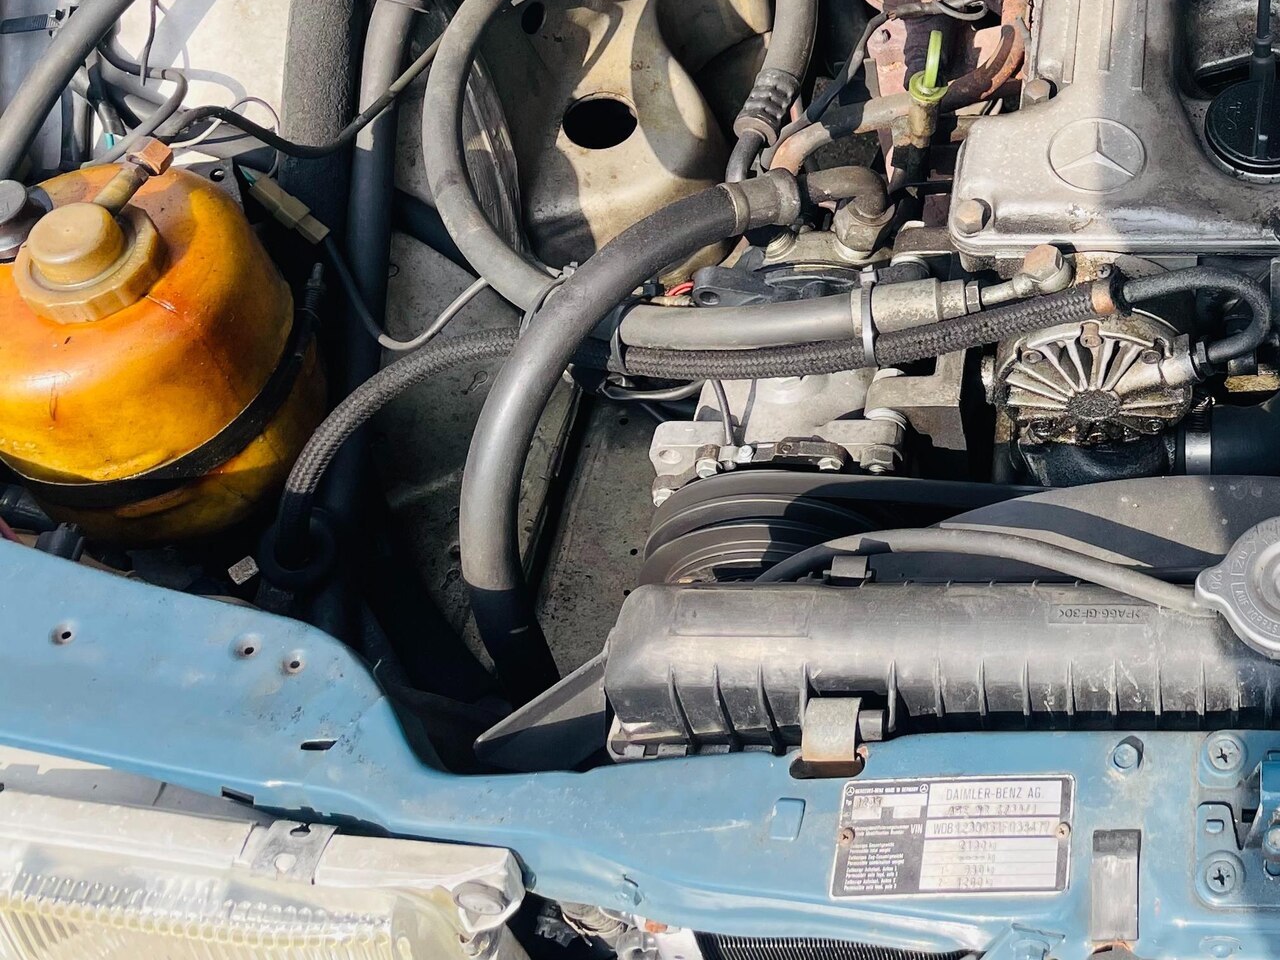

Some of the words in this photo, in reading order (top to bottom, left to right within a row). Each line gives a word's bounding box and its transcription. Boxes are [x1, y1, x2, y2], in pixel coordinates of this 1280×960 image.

[1236, 589, 1250, 607] AUF
[946, 788, 1022, 801] DAIMLER-BENZ
[1027, 787, 1042, 798] AG
[910, 823, 923, 834] VIN
